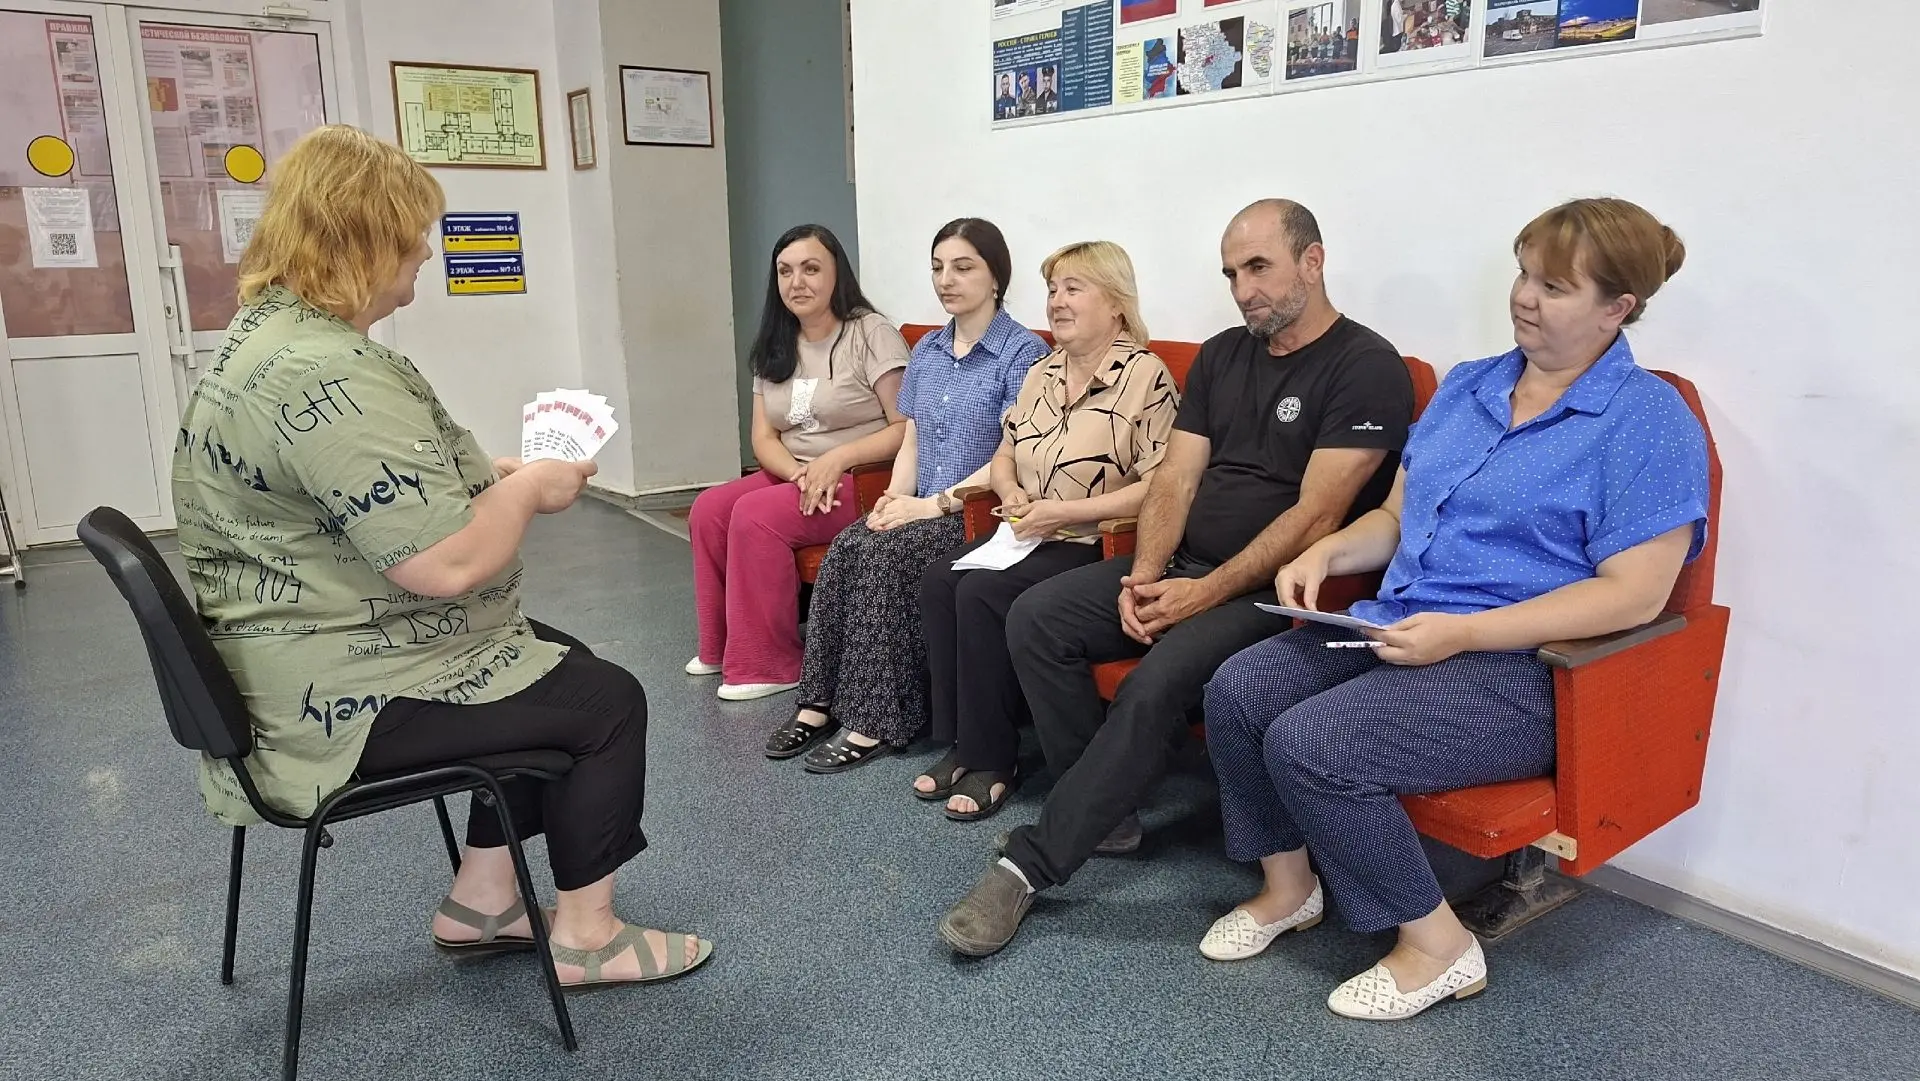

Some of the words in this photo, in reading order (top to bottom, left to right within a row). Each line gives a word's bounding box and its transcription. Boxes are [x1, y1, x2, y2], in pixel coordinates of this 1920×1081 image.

[455, 266, 475, 274] ЭТАЖ
[245, 513, 276, 529] future
[236, 620, 275, 632] dream
